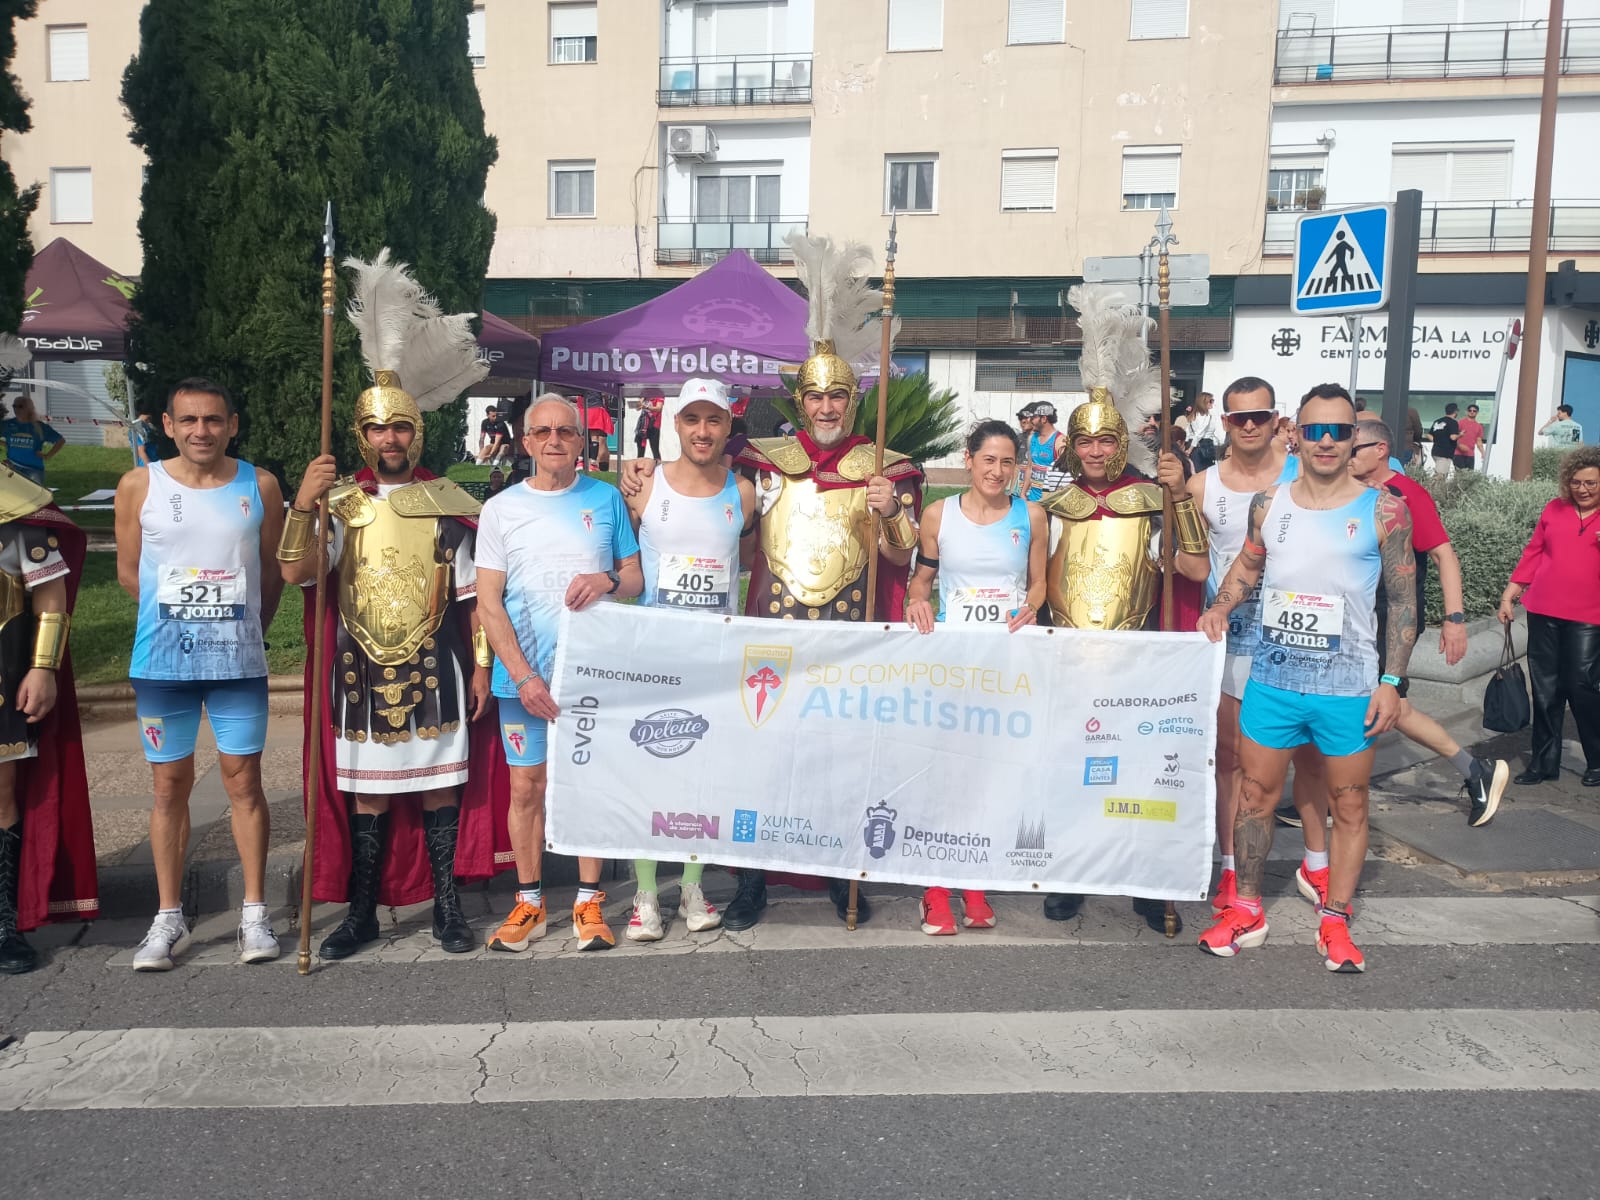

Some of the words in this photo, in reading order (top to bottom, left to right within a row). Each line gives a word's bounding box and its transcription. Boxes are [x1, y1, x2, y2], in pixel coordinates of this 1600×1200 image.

[1321, 325, 1443, 343] FARMCIA
[1452, 330, 1471, 343] LA
[17, 336, 103, 351] nsable
[551, 347, 642, 372] Punto
[649, 347, 759, 374] Violeta
[1320, 349, 1370, 359] CENTO
[1431, 349, 1491, 359] AUDITIVO
[169, 494, 182, 522] evelb
[660, 499, 670, 521] evelb
[1216, 496, 1226, 525] evelb
[1277, 513, 1292, 543] evelb
[542, 570, 582, 588] 66
[676, 573, 714, 591] 405
[180, 585, 222, 603] 521
[963, 604, 1000, 622] 709
[1278, 611, 1319, 632] 482
[576, 666, 681, 686] PATROCINADORES
[804, 664, 842, 685] SD
[849, 663, 1032, 697] COMPOSTELA
[1093, 693, 1198, 708] COLABORADORES
[799, 685, 1032, 739] Atletismo
[570, 696, 599, 765] evelb
[637, 719, 704, 744] Deleite
[1085, 733, 1122, 741] GARABAL
[1154, 778, 1184, 788] AMIGO
[1108, 802, 1143, 815] J.M.D.
[762, 814, 813, 831] XUNTA
[760, 830, 780, 842] DE
[784, 832, 843, 849] GALICIA
[904, 825, 991, 848] Deputación
[901, 843, 922, 858] DA
[926, 844, 988, 864] CORUÑA
[1005, 851, 1042, 859] CONCELLO
[1044, 851, 1053, 859] DE
[1010, 859, 1047, 867] SANTIAGO
